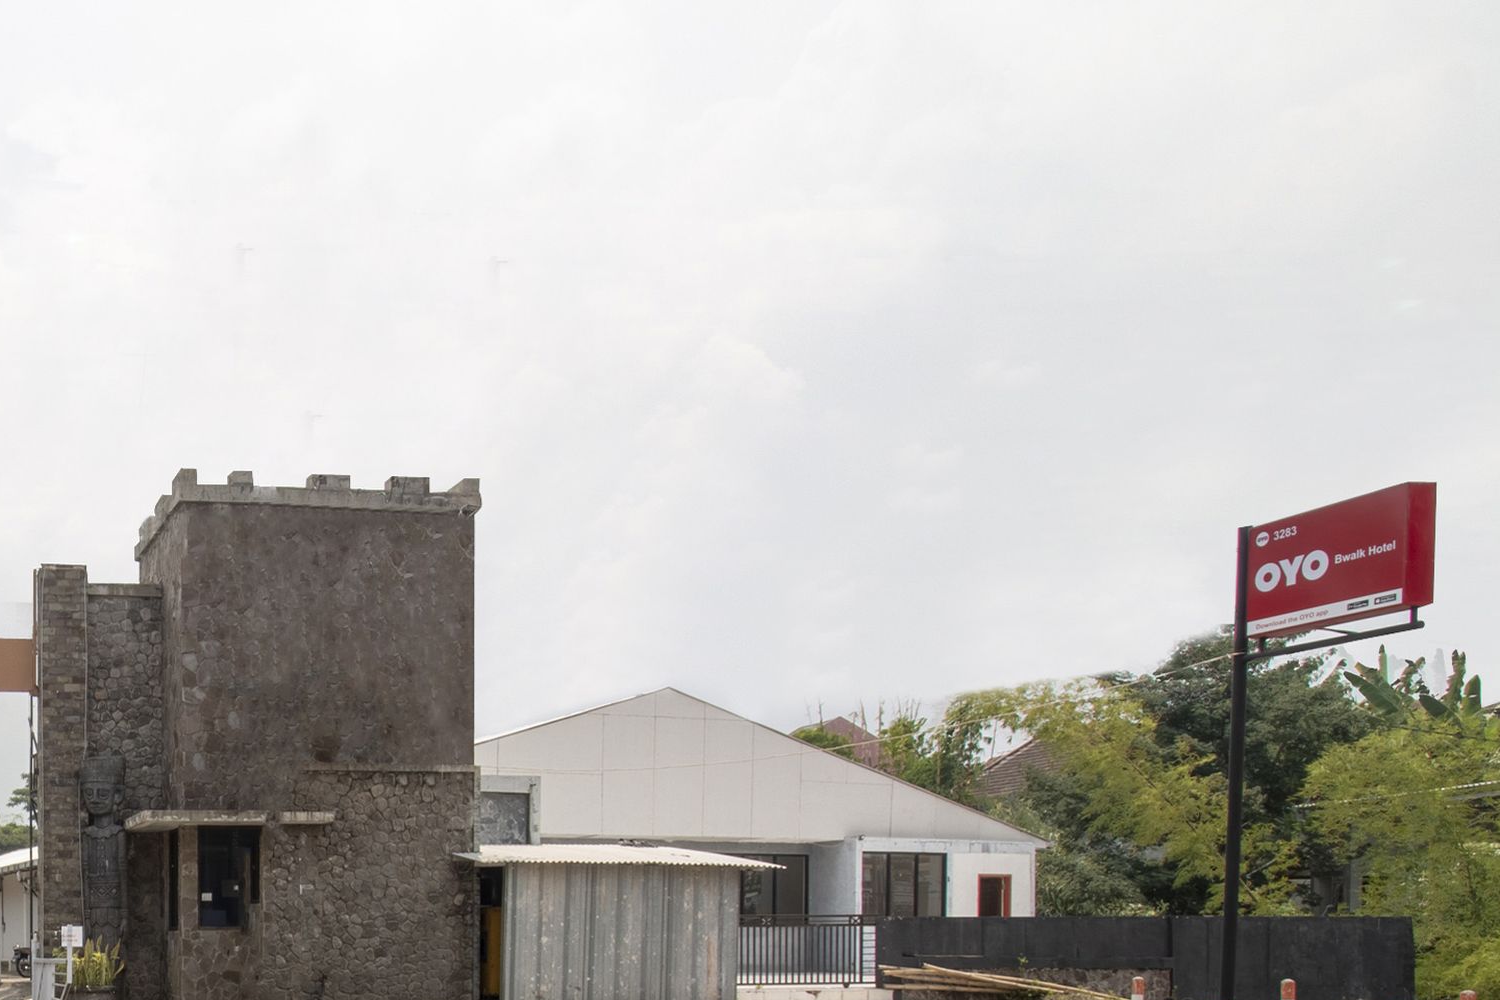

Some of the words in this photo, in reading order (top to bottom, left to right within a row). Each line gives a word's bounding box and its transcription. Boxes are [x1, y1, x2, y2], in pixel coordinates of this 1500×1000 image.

[1273, 526, 1297, 541] 3283
[1255, 550, 1329, 593] OYO
[1334, 549, 1366, 565] Bwalk
[1368, 540, 1396, 557] Hotel
[1299, 612, 1315, 621] OYO
